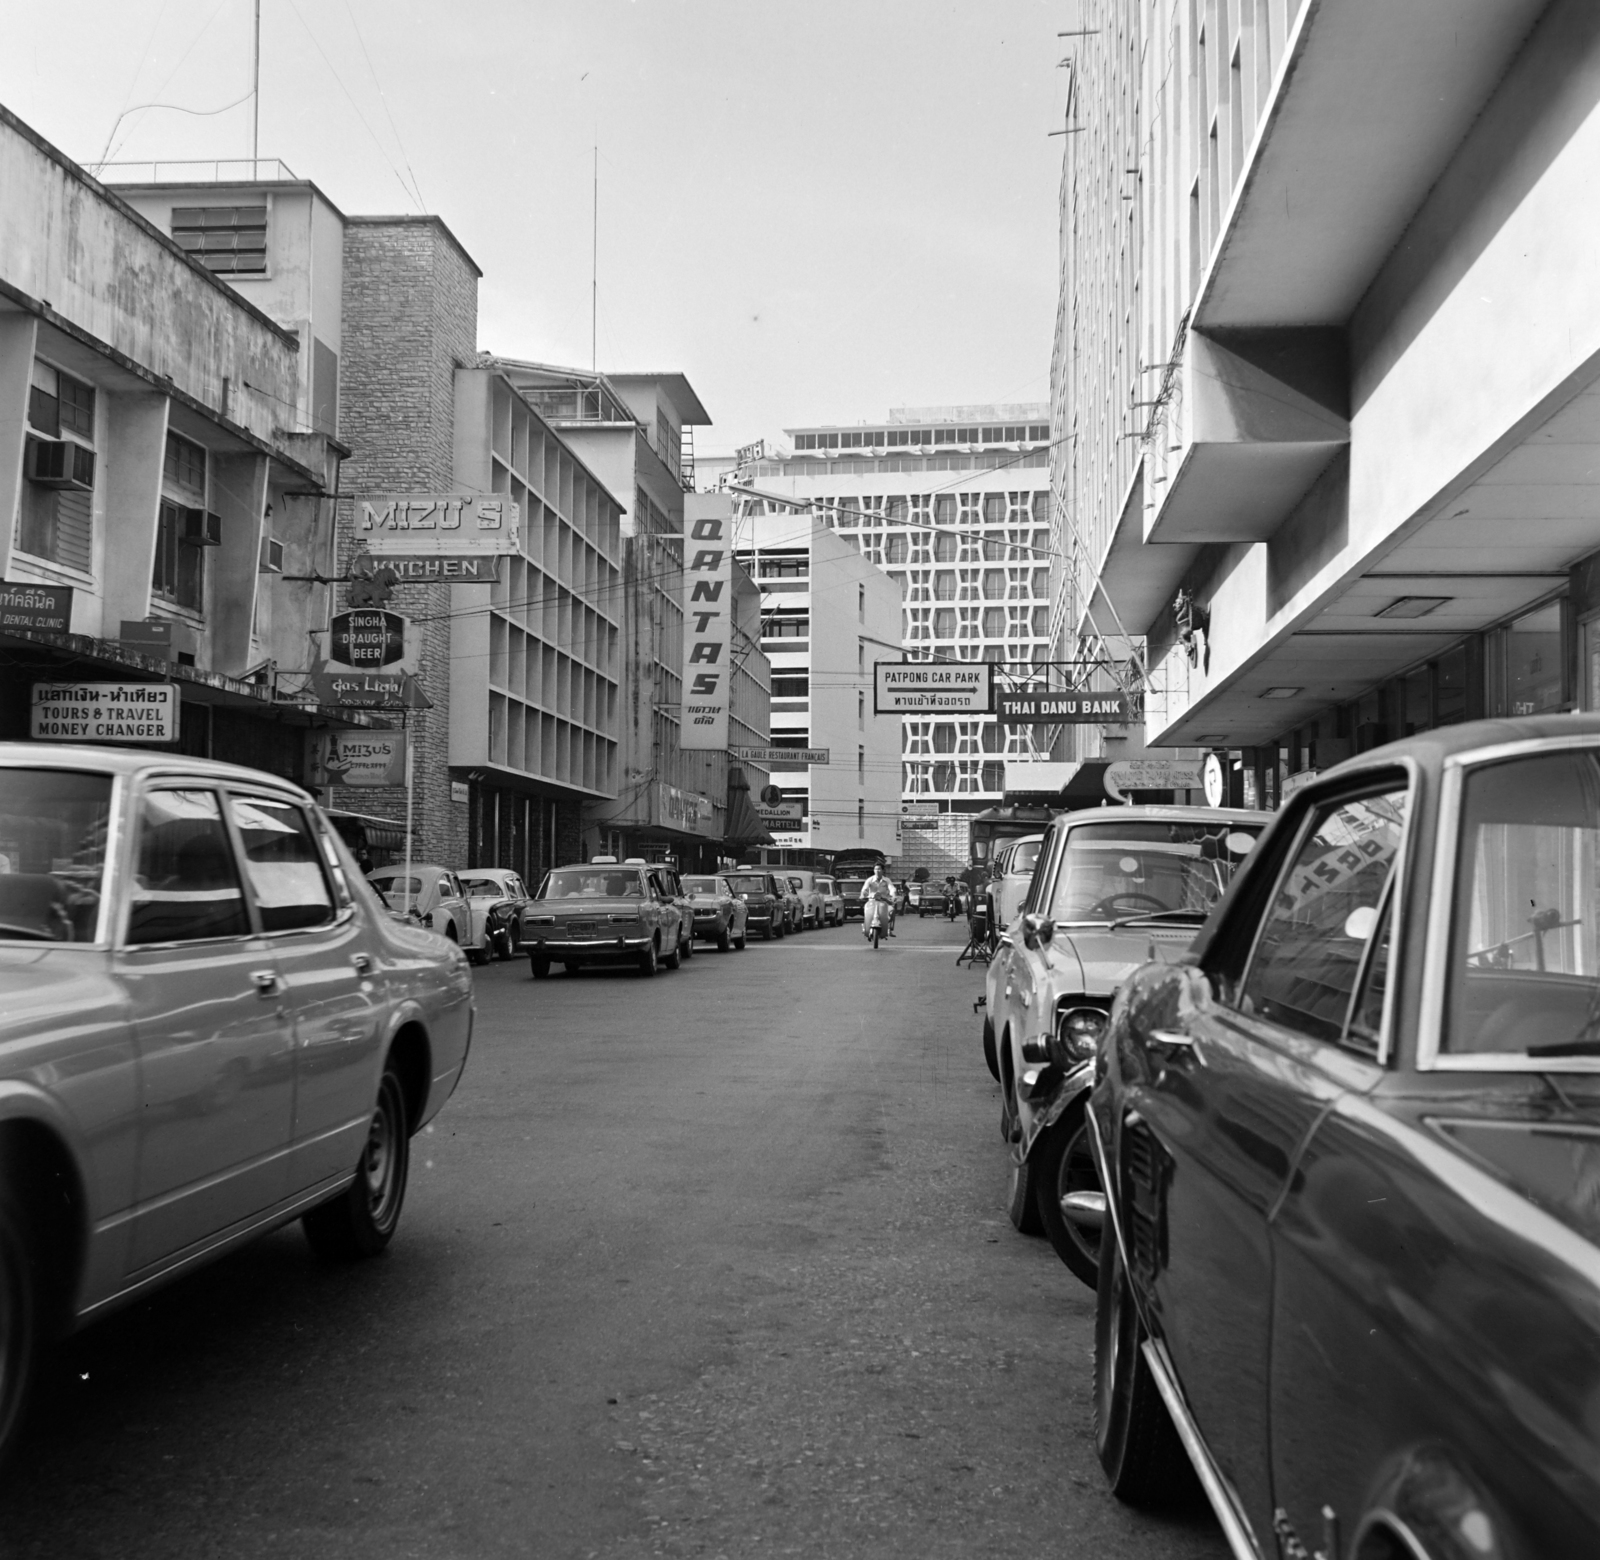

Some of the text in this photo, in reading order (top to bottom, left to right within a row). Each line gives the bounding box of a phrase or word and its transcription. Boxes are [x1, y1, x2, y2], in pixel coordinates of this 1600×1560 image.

[361, 497, 503, 530] MIZU'S
[689, 519, 724, 695] QANTAS
[3, 615, 64, 629] DENTAL CLINIC
[348, 617, 387, 627] SINGHA
[342, 633, 392, 644] DRAUGHT
[354, 648, 381, 659] BEER
[885, 672, 980, 683] PATPONG CAR PARK
[1003, 700, 1120, 714] THAI DANU BANK
[42, 707, 163, 721] TOURS & TRAVEL
[39, 723, 165, 736] MONEY CHANGER
[741, 750, 748, 758] LA
[769, 752, 800, 760] RESTAURANT
[801, 753, 826, 762] FRANÇAIS
